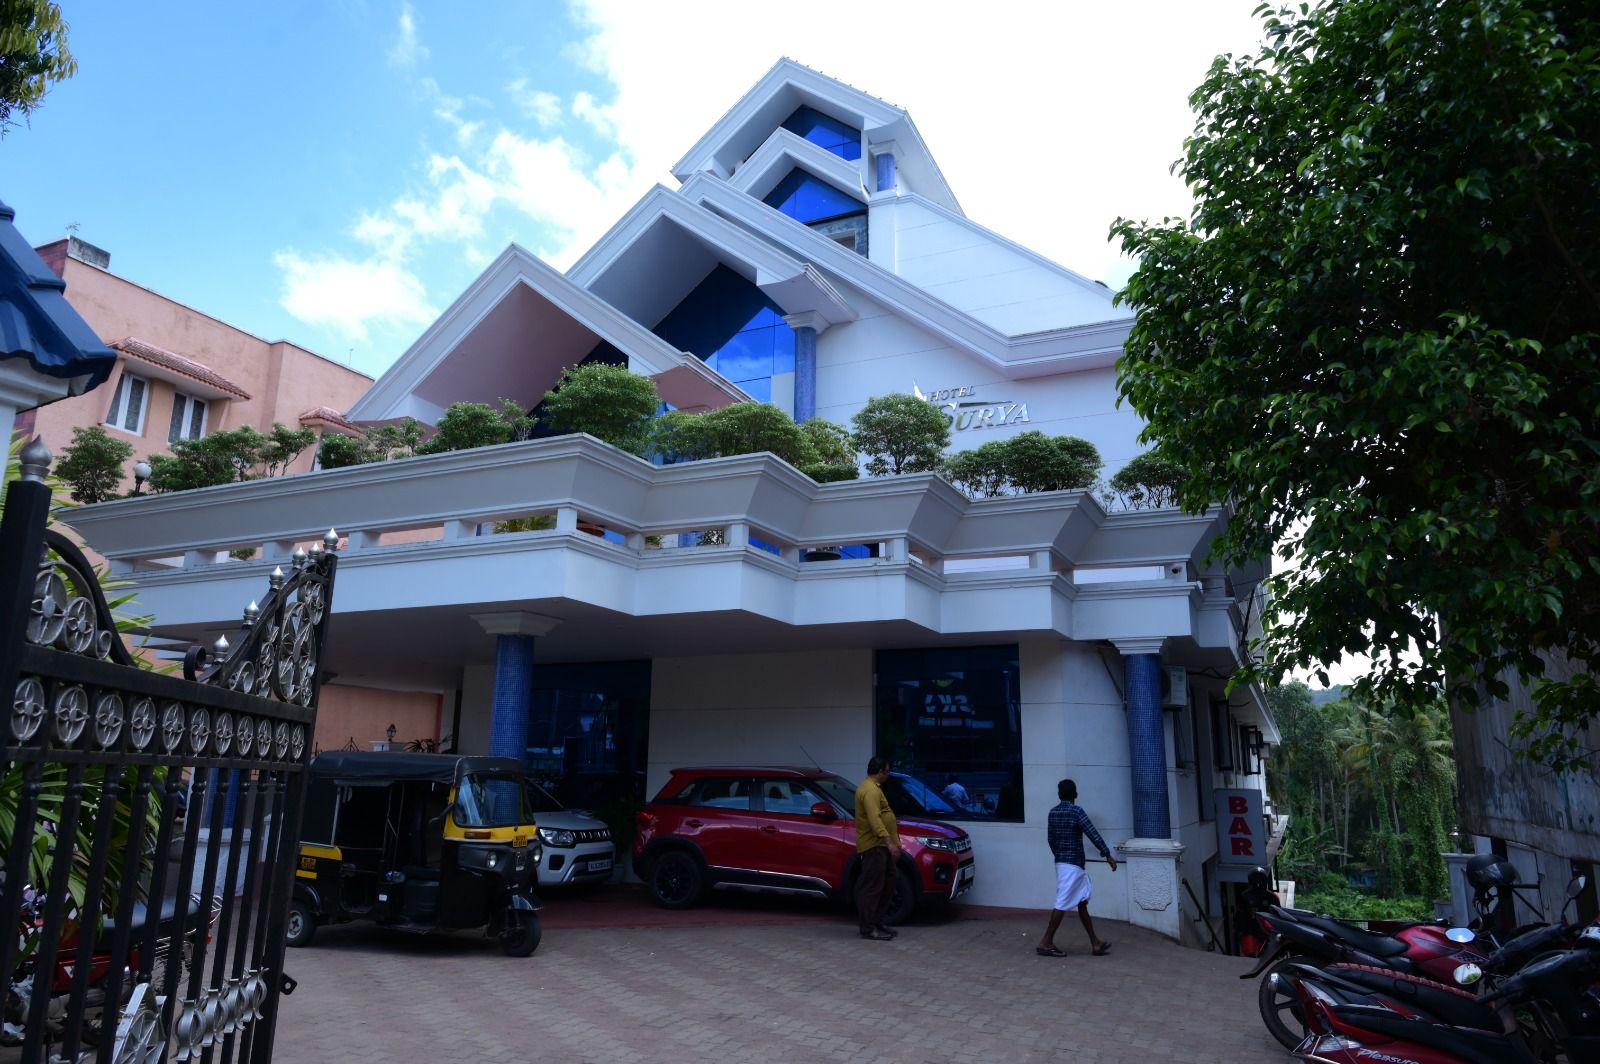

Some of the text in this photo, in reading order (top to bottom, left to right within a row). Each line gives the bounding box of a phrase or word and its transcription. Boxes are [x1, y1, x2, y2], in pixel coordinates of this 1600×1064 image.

[930, 385, 976, 401] HOTEL
[938, 401, 1031, 431] SURYA
[1228, 795, 1255, 856] BAR
